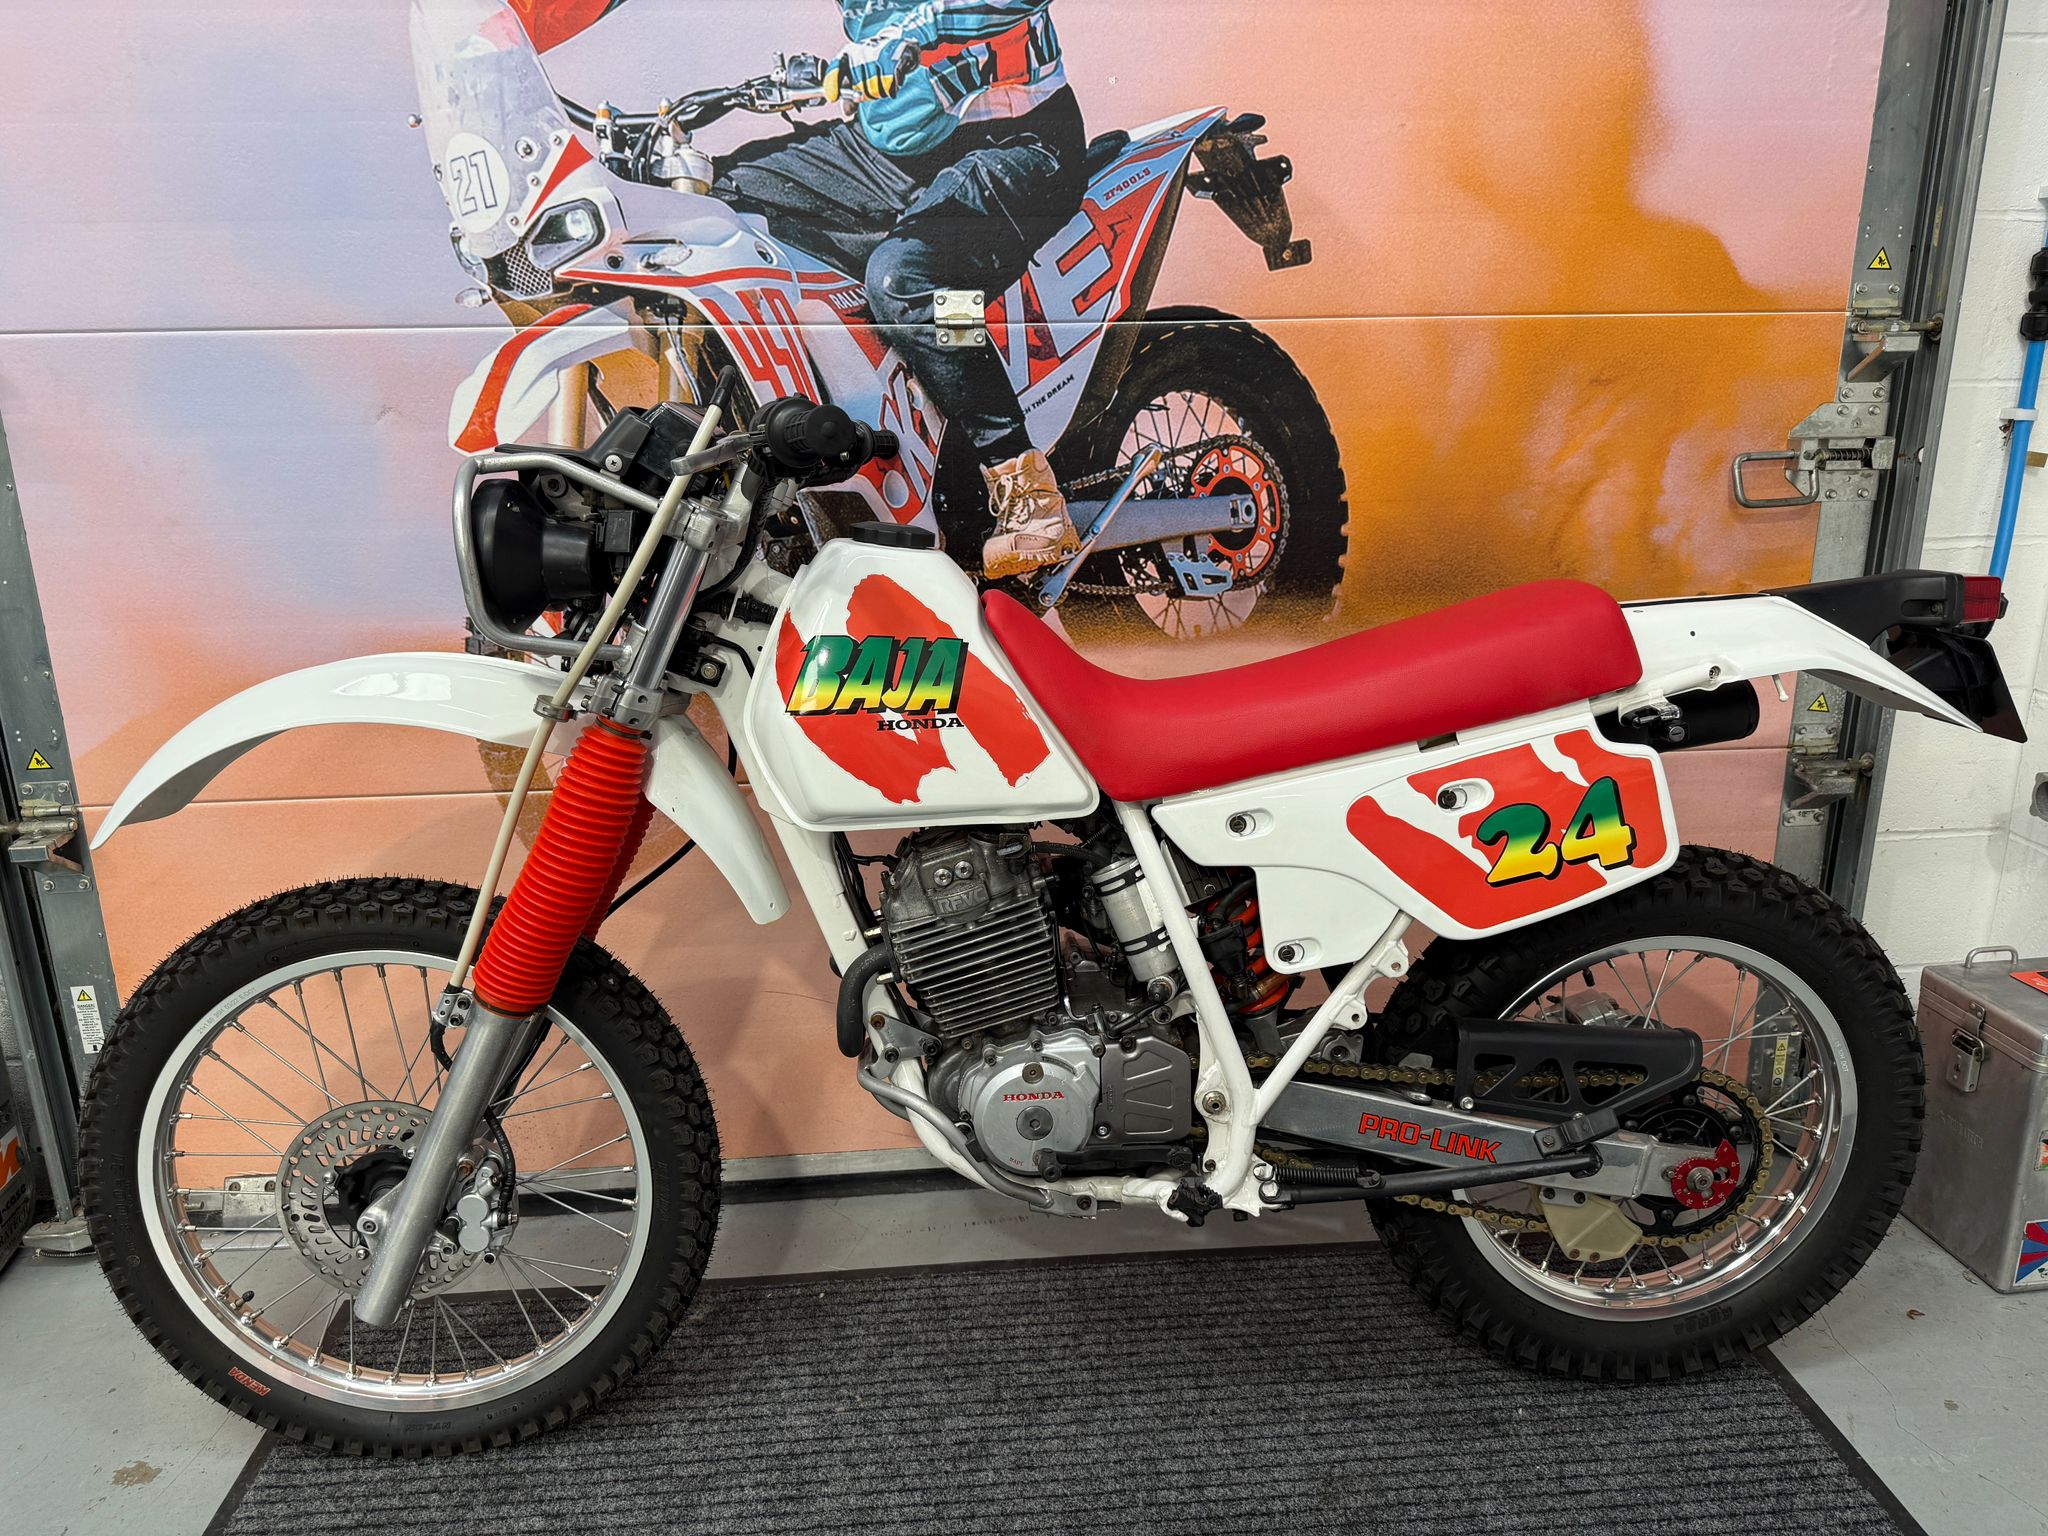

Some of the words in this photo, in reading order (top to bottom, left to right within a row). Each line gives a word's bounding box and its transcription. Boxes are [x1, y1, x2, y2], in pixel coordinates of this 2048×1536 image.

[450, 150, 498, 216] 21
[1031, 396, 1046, 409] THE
[1046, 374, 1075, 399] DREAM
[785, 634, 969, 716] BAJA
[876, 717, 964, 732] HONDA
[1482, 775, 1637, 888] 24
[1003, 1091, 1065, 1102] HONDA
[1358, 1112, 1502, 1163] PRO-LINK
[227, 1366, 272, 1397] KENDA
